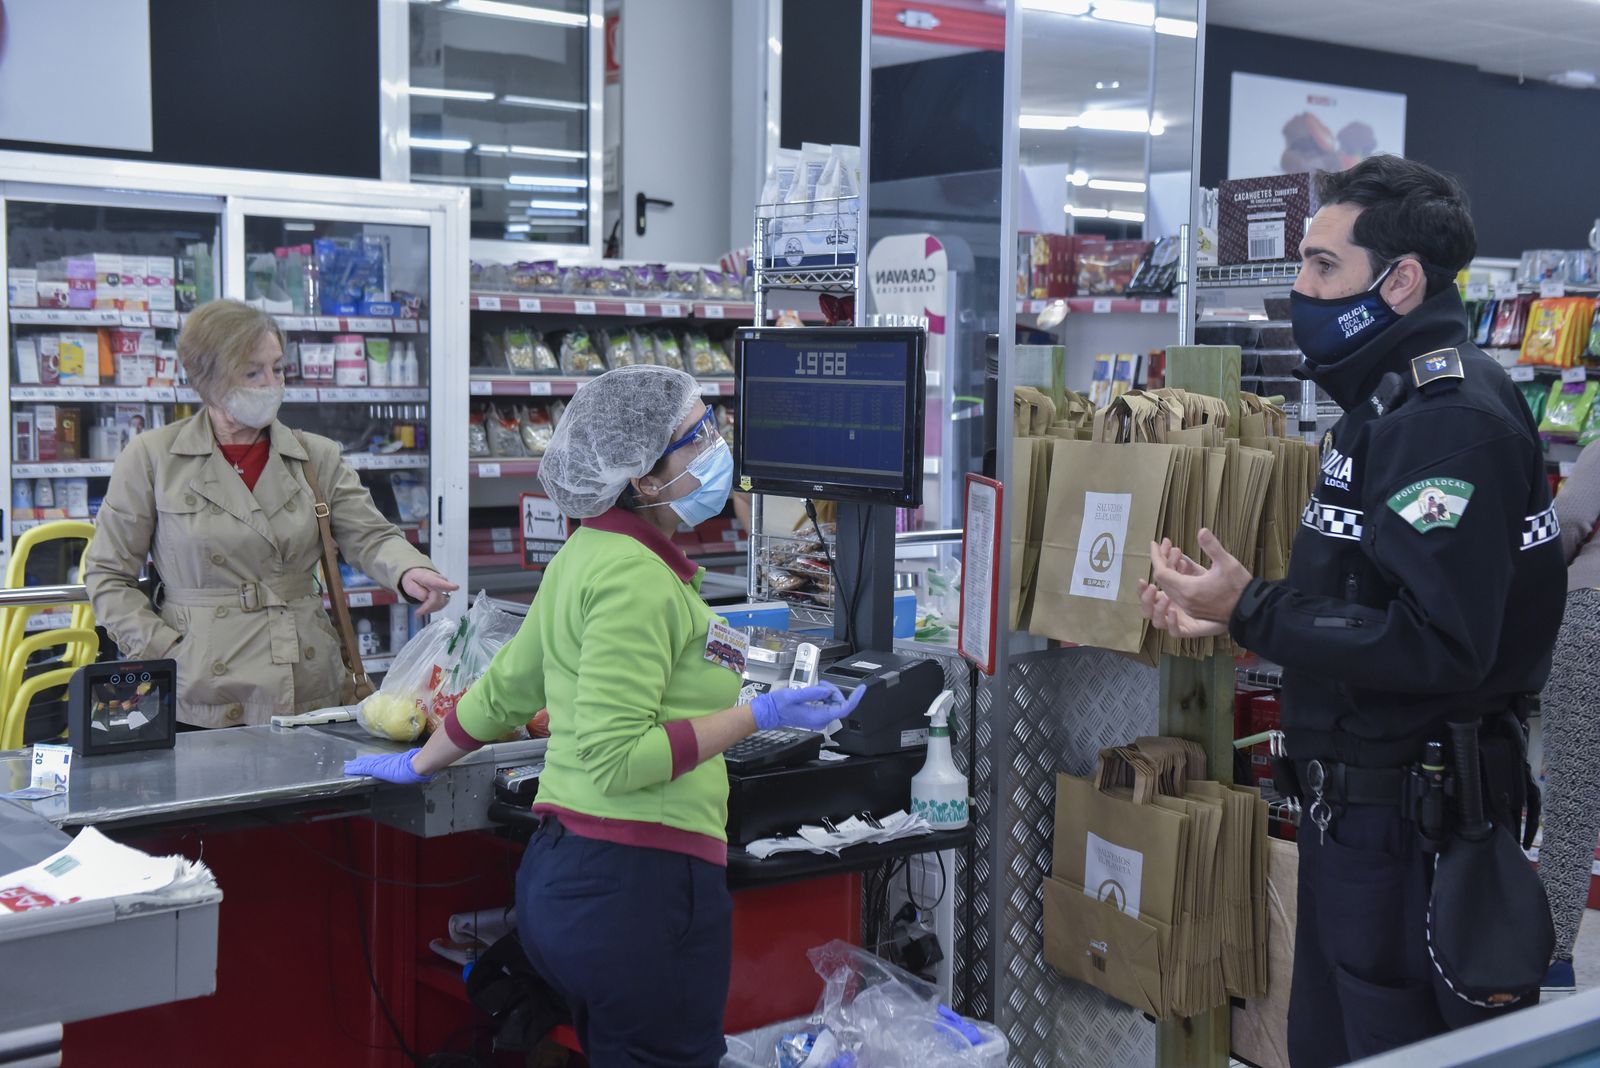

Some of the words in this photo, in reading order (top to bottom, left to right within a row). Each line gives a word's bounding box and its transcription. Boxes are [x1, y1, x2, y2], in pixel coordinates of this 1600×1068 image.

[1234, 189, 1272, 201] CACAHUETES
[1341, 316, 1361, 332] LOCAL
[1345, 315, 1376, 339] ALBAIDA
[1325, 476, 1350, 492] LOCAL
[1435, 479, 1466, 490] LOCAL
[35, 752, 43, 765] 20
[54, 774, 67, 793] 20
